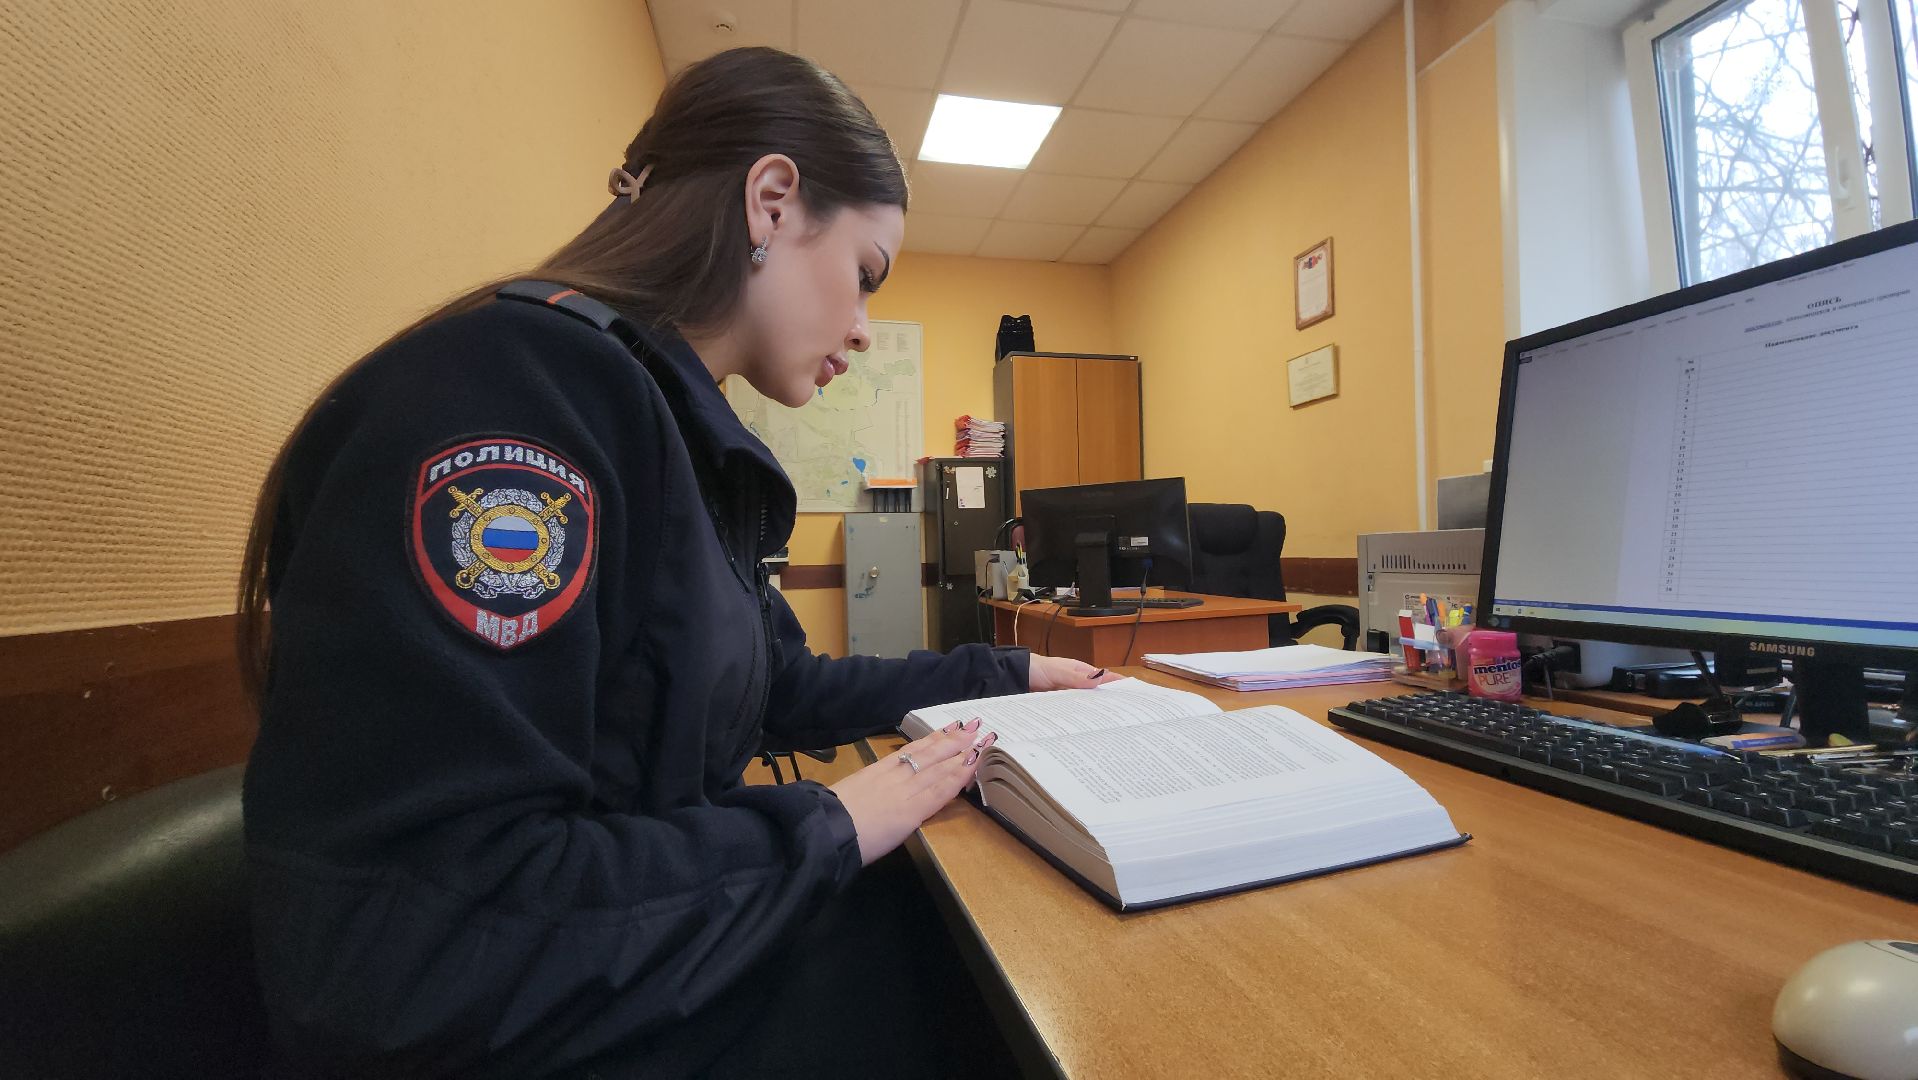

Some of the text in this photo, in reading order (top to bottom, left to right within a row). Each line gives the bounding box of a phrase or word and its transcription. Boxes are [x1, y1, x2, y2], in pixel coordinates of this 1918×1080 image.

[429, 445, 586, 494] ПОЛИЦИЯ
[476, 609, 538, 648] МВД
[1749, 641, 1815, 657] SAMSUNG
[1478, 672, 1511, 686] PURE
